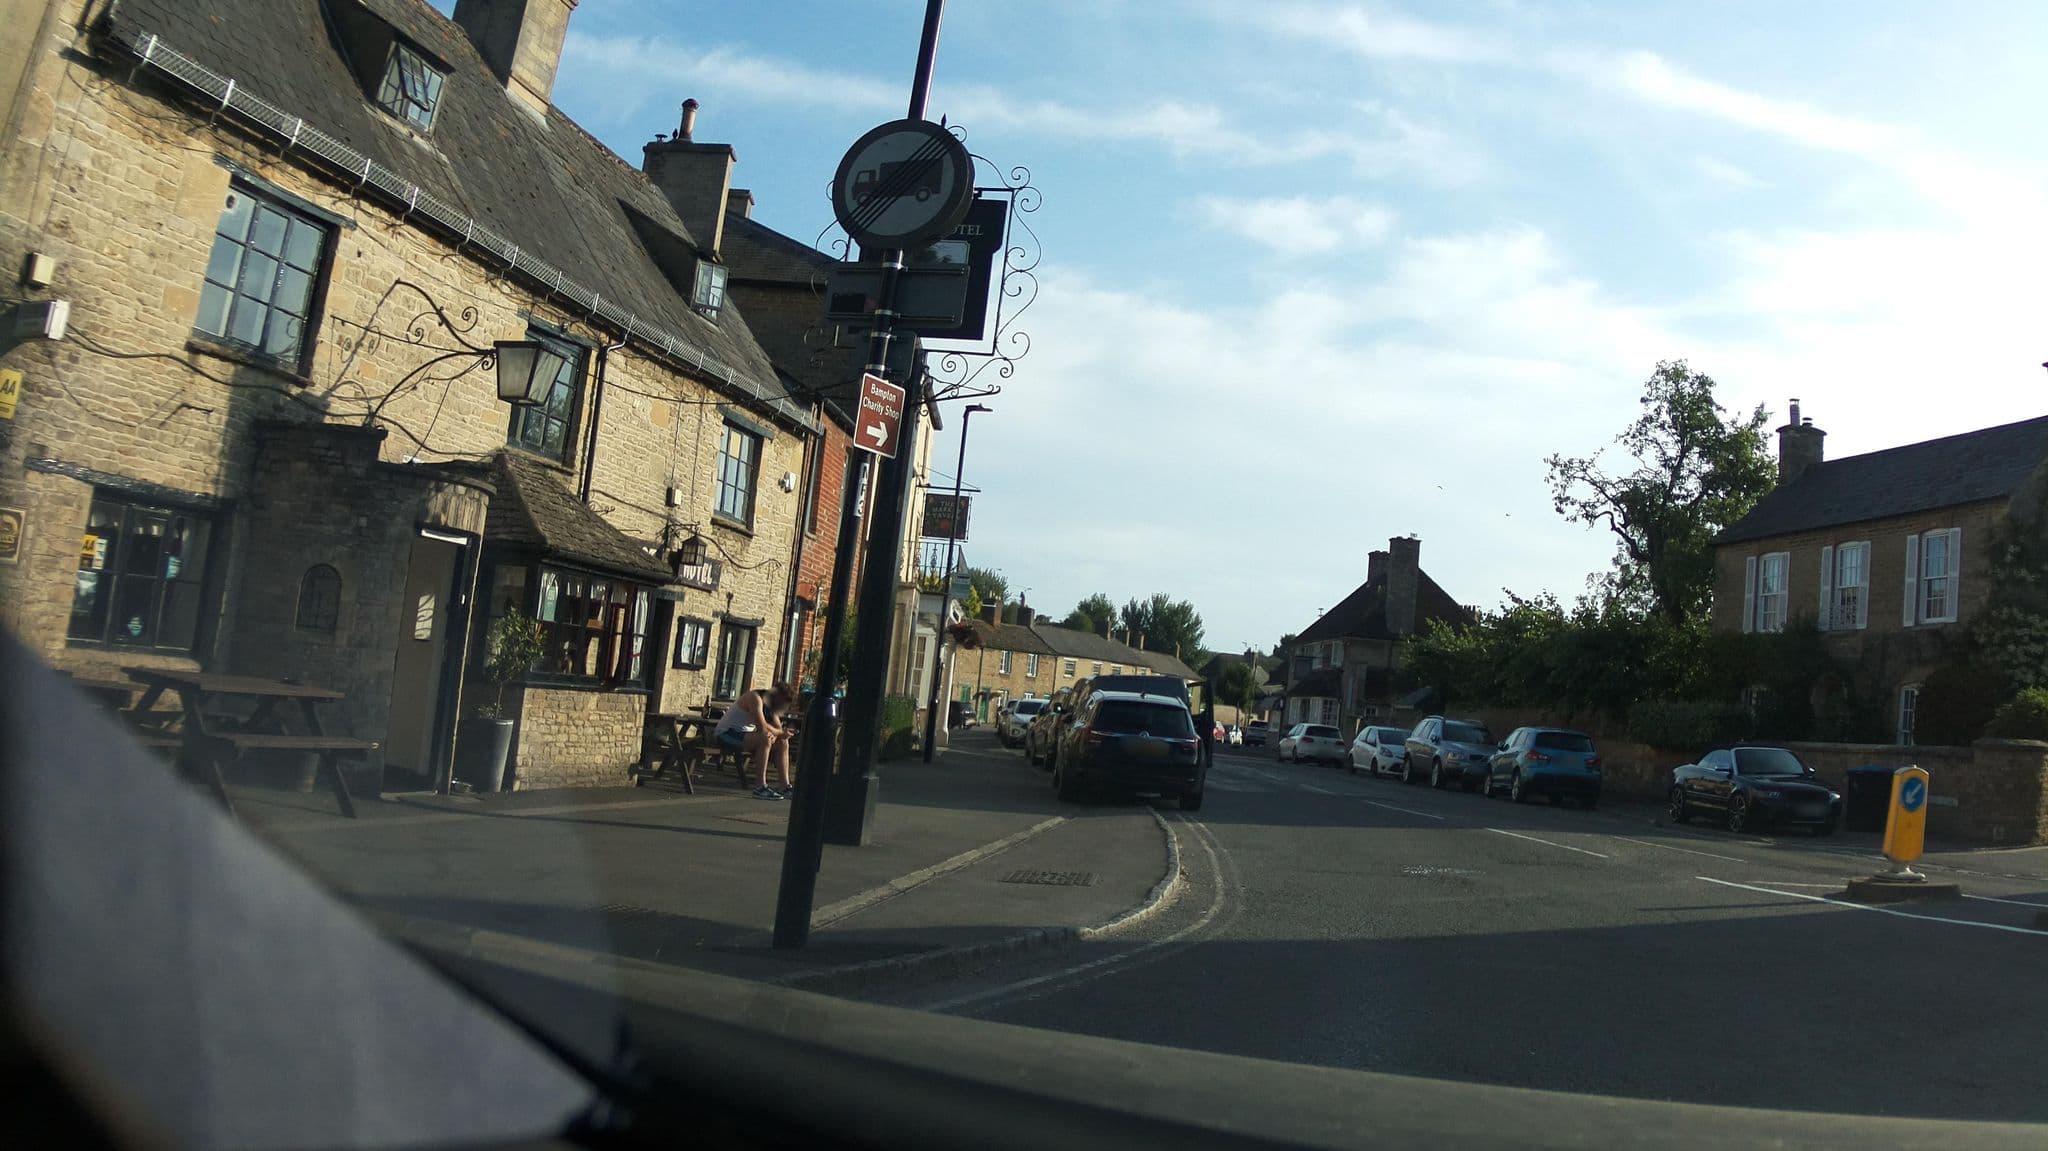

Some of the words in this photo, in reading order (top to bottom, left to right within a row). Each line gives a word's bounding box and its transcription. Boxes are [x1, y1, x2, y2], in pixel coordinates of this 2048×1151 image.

[0, 378, 17, 396] AA
[871, 383, 897, 403] Bampton
[862, 396, 884, 415] Charity
[885, 405, 900, 421] Shop
[683, 562, 713, 585] HOTEL
